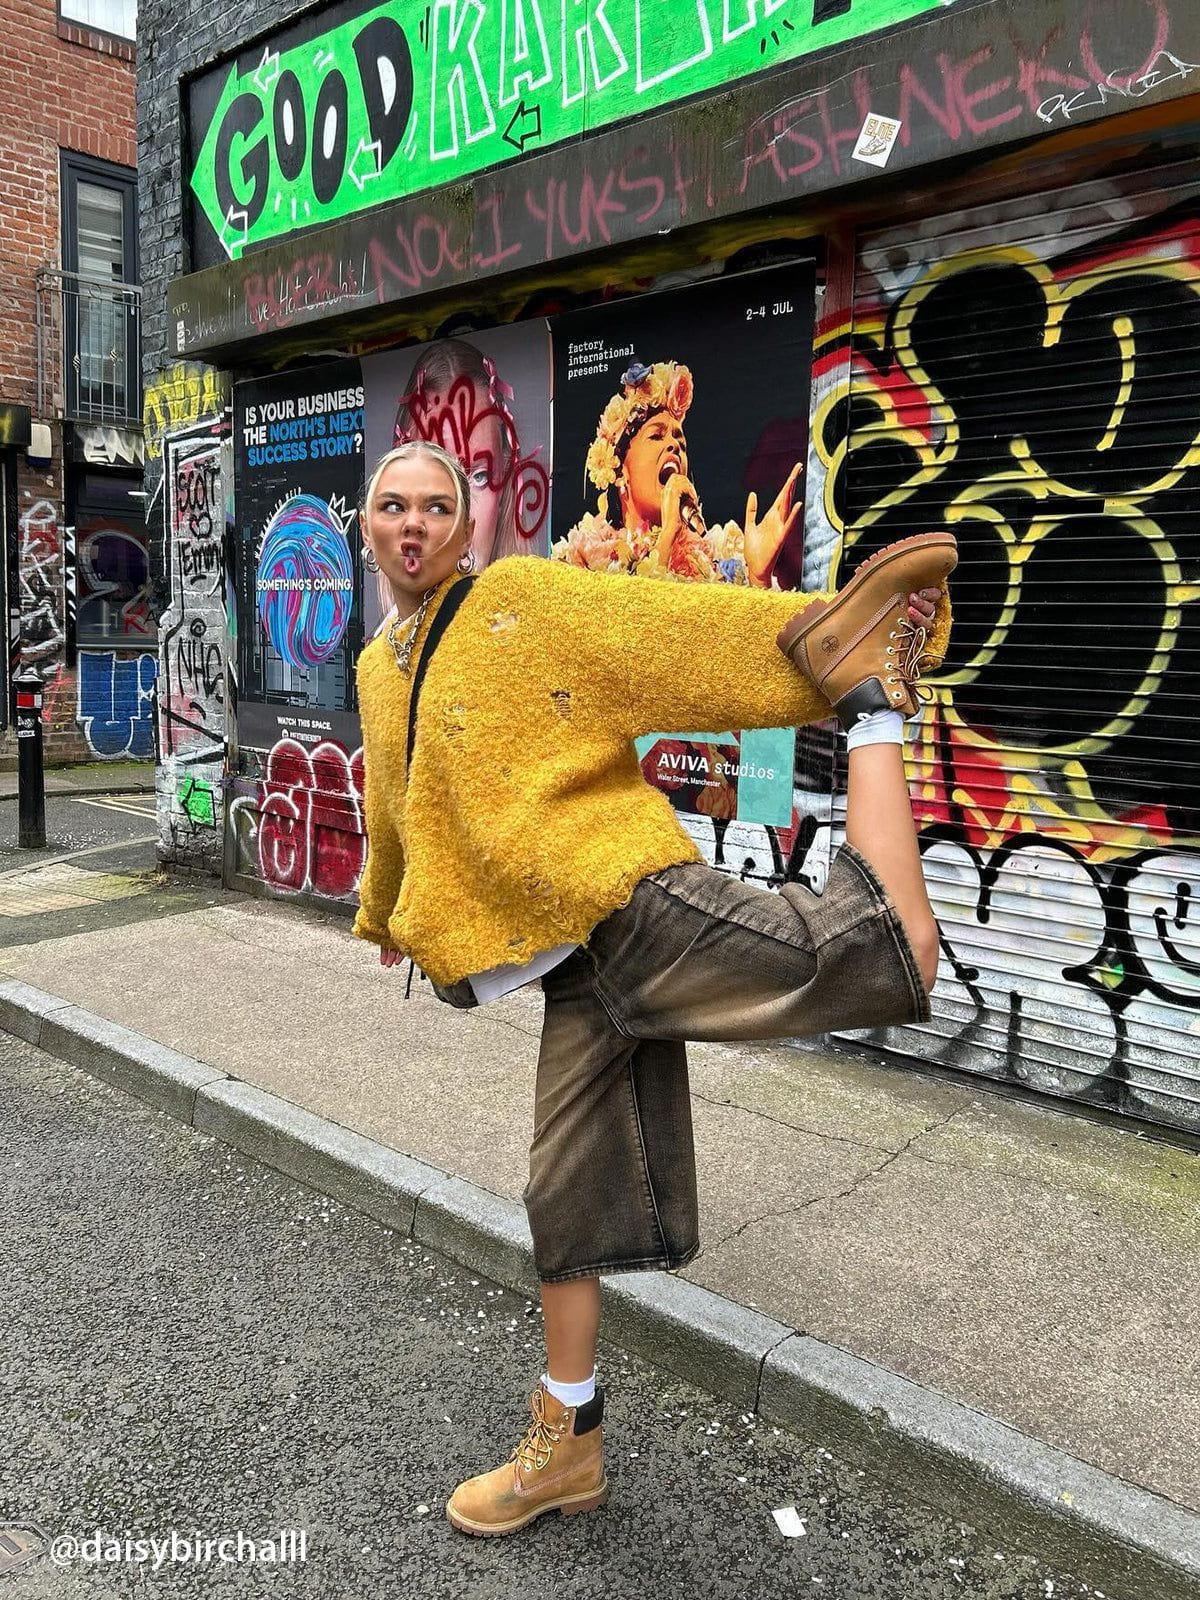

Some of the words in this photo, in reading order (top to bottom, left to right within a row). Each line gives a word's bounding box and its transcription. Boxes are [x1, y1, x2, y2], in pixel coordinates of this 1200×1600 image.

[214, 16, 414, 232] GOOD
[864, 118, 896, 142] ELITE
[746, 305, 766, 320] 2-4
[772, 301, 793, 315] JUL
[568, 340, 604, 354] factory
[568, 344, 635, 366] international
[568, 363, 609, 380] presents
[245, 406, 257, 426] IS
[259, 399, 295, 423] YOUR
[298, 386, 365, 417] BUSINESS
[243, 425, 267, 446] THE
[269, 416, 326, 443] NORTH'S
[248, 442, 308, 467] SUCCESS
[310, 433, 363, 459] STORY?
[257, 579, 312, 591] SOMETHING'S
[313, 578, 354, 591] COMING.
[277, 716, 297, 727] WATCH
[298, 718, 311, 729] THIS
[311, 720, 332, 731] SPACE.
[658, 752, 709, 774] AVIVA
[714, 760, 775, 781] studios
[690, 777, 721, 788] Manchester
